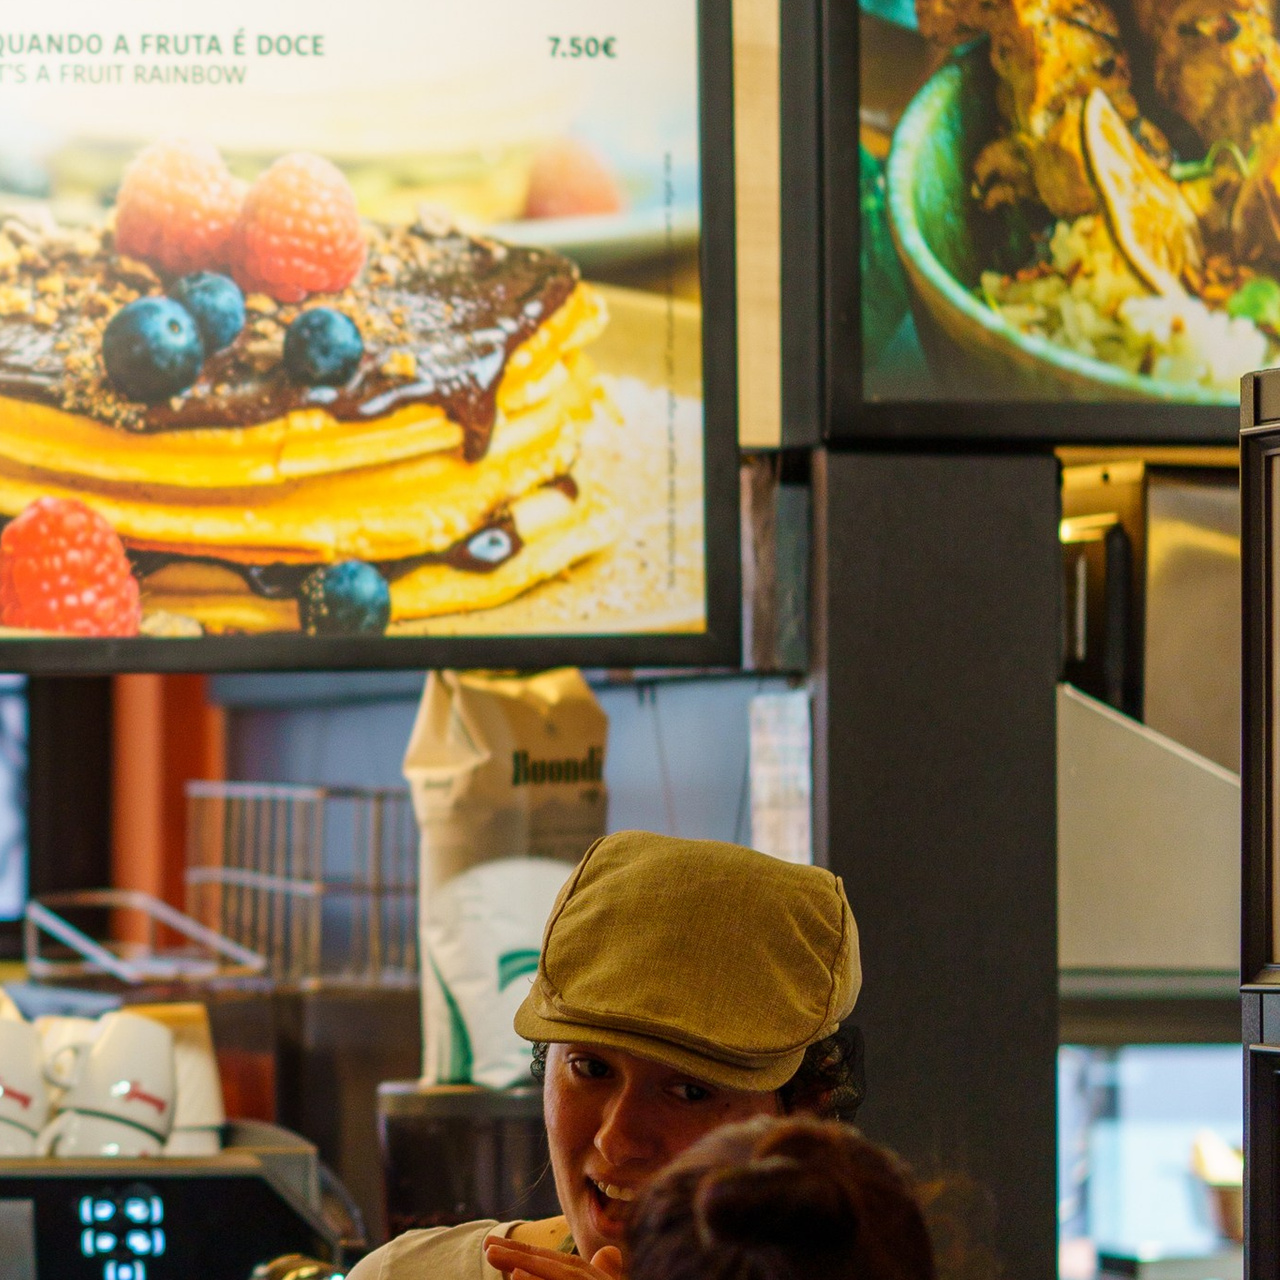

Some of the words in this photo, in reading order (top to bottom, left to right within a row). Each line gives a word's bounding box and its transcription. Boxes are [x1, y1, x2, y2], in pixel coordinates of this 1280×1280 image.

[113, 34, 130, 54] A
[141, 34, 223, 55] FRUTA
[233, 28, 245, 56] É
[257, 35, 324, 56] DOCE
[549, 36, 616, 59] 7.50€
[36, 64, 50, 83] A
[59, 63, 125, 84] FRUIT
[134, 64, 247, 85] RAINBOW
